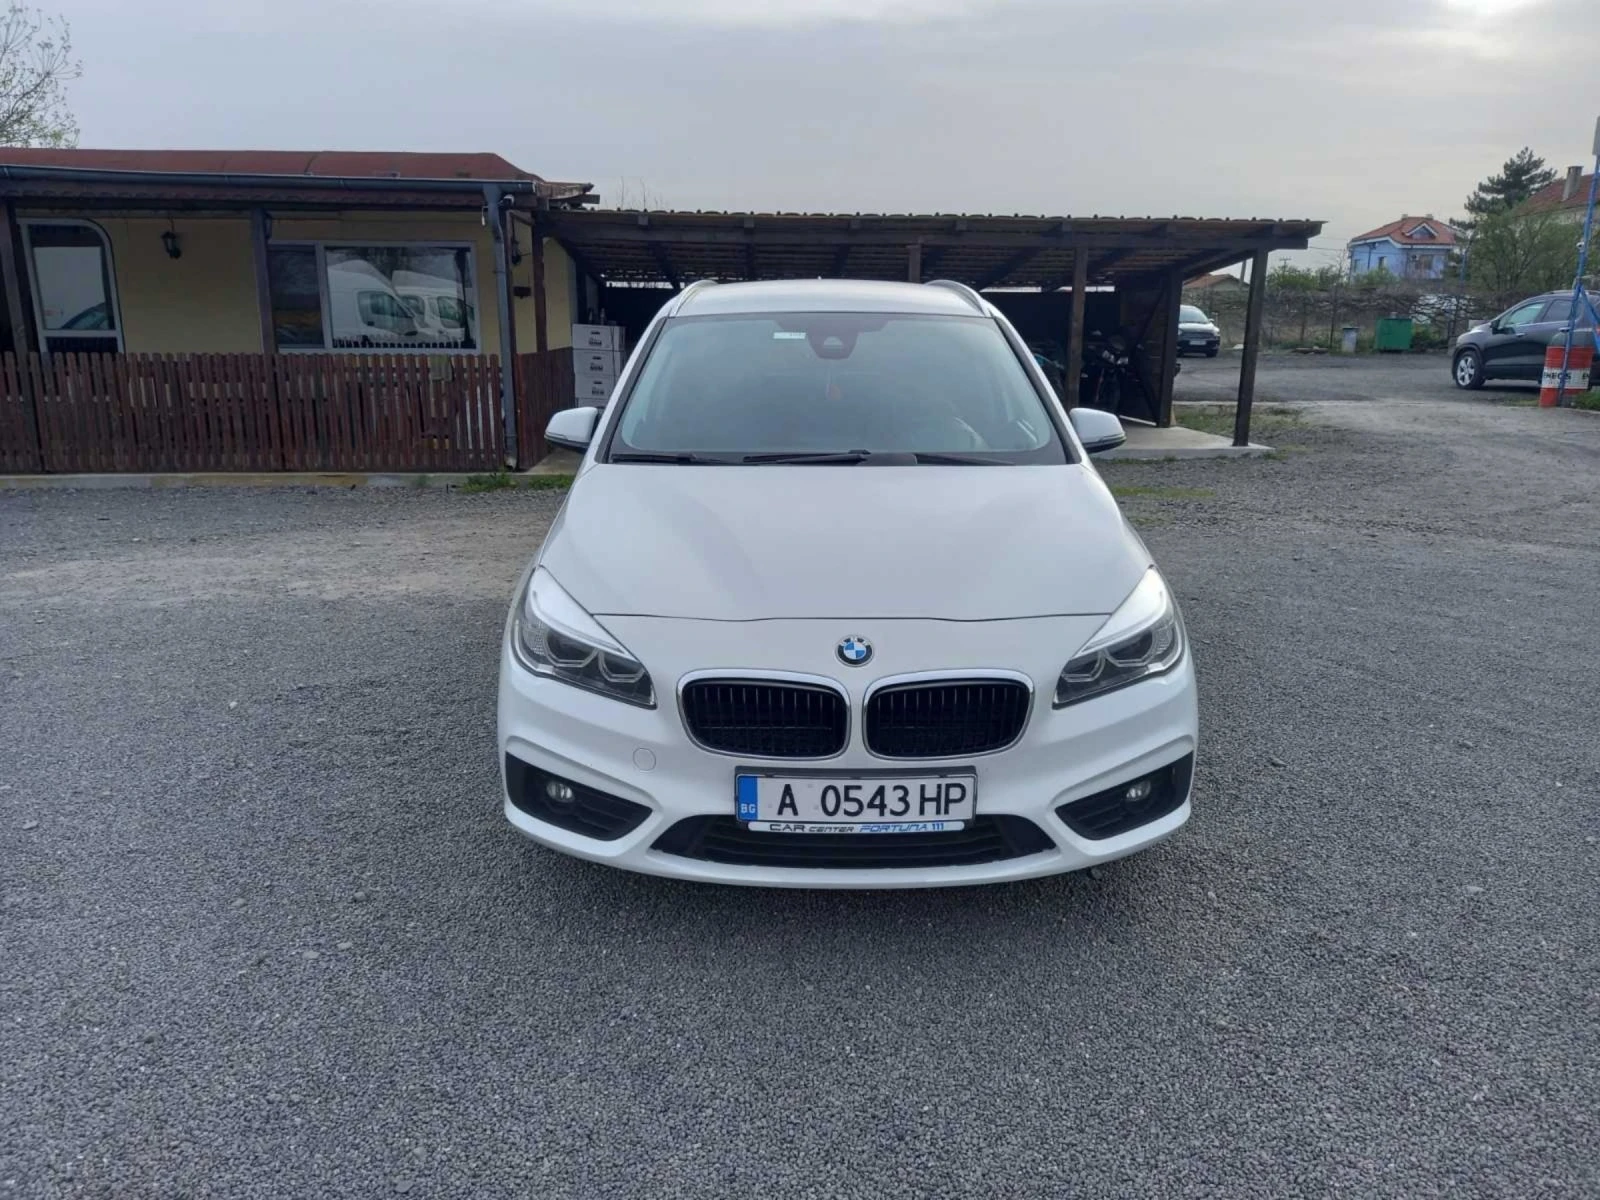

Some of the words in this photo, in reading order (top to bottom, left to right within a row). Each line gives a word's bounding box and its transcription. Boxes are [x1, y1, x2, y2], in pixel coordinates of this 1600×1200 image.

[777, 783, 799, 816] A
[820, 784, 911, 817] 0543
[918, 783, 967, 816] HP
[740, 803, 756, 814] BG
[769, 823, 806, 832] CAR
